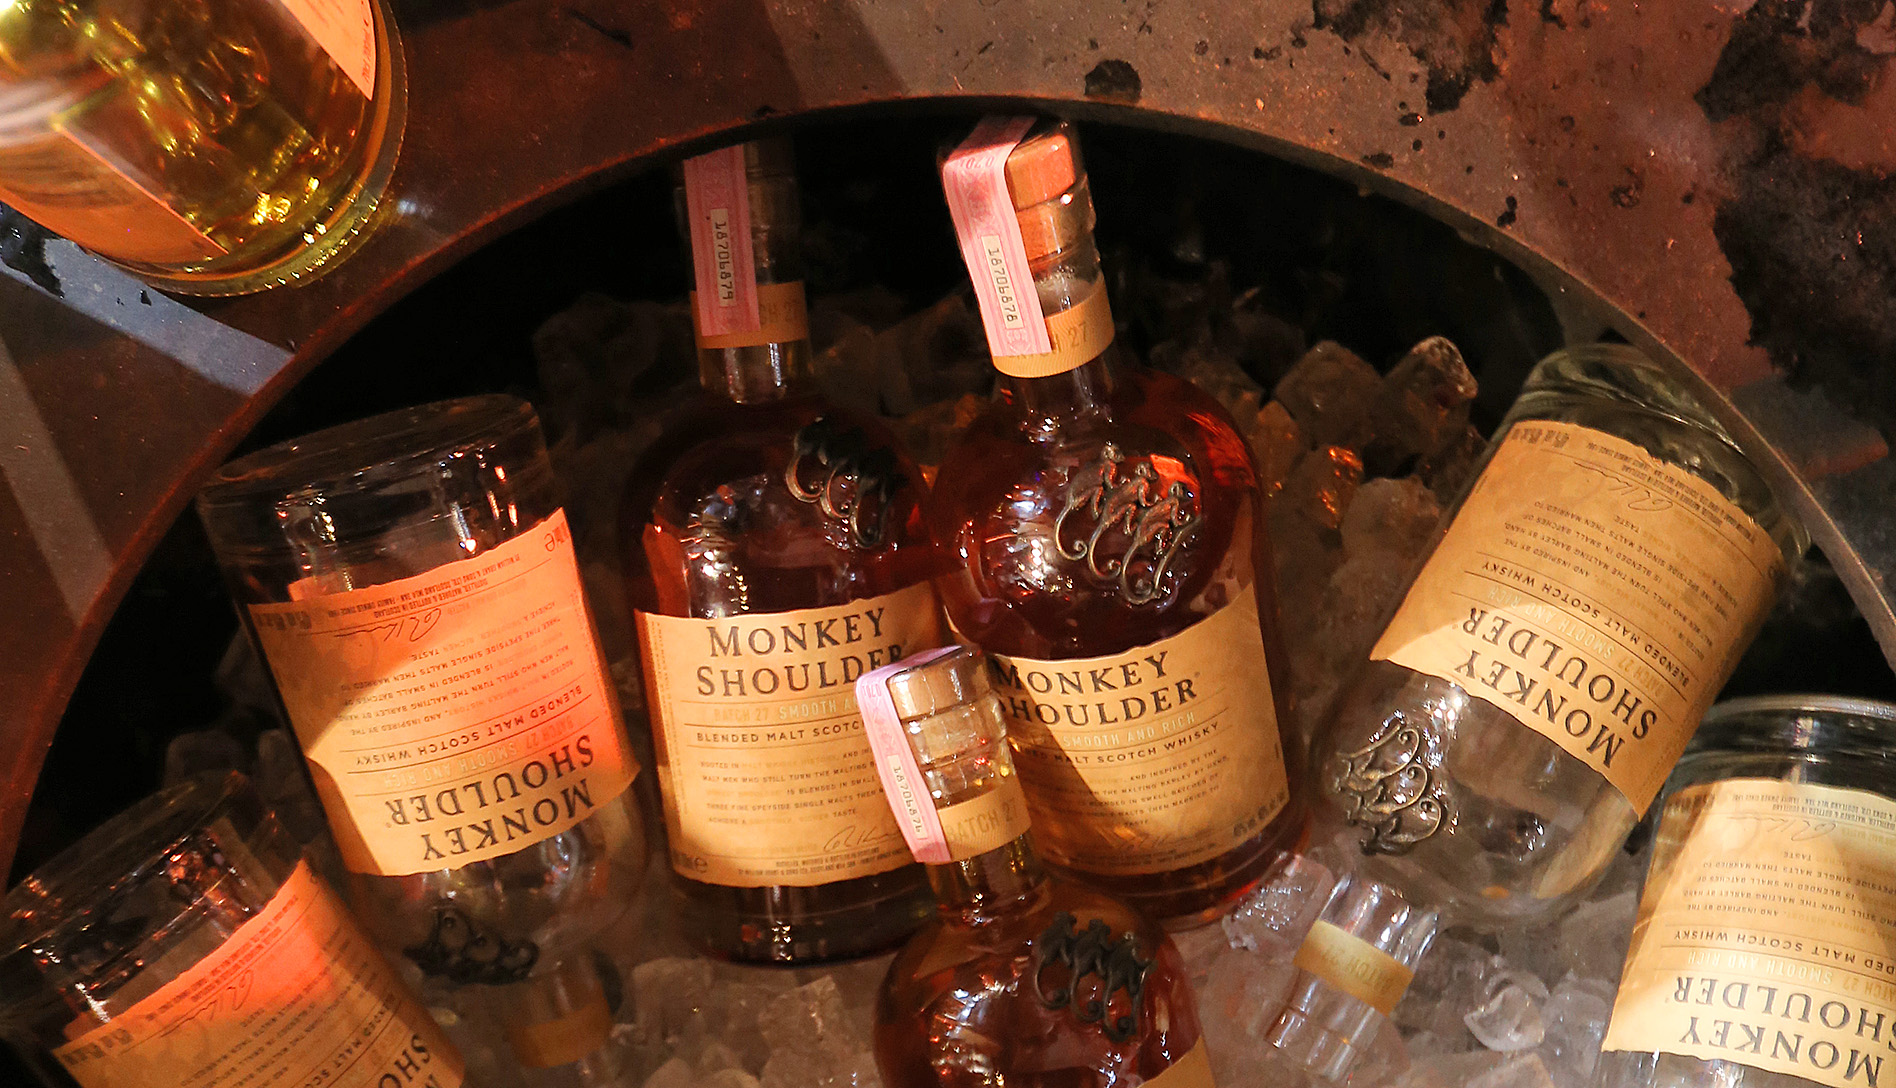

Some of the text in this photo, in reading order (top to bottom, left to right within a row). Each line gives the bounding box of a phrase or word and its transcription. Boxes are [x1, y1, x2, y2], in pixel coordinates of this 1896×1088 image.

[714, 221, 733, 300] 18706879
[986, 246, 1019, 324] 18706878
[1068, 324, 1089, 349] 27
[1536, 516, 1572, 534] BATCHES
[1584, 519, 1606, 533] THEN
[1541, 535, 1572, 552] BARLEY
[1576, 531, 1602, 548] SMALL
[1609, 530, 1635, 548] MALTS
[1504, 538, 1589, 577] AND INSPIRED BY THE
[1573, 548, 1610, 570] MALTING
[1616, 552, 1652, 577] BLENDED
[1637, 545, 1666, 567] SINGLE
[1482, 561, 1535, 587] WHISKY
[1611, 567, 1627, 581] THE
[1667, 564, 1700, 593] SPEYSIDE
[1630, 578, 1650, 594] TURN
[1542, 583, 1600, 618] SCOTCH
[1653, 592, 1672, 610] STILL
[706, 607, 884, 657] MONKEY
[1604, 617, 1640, 645] MALT
[485, 634, 522, 654] SPEYSIDE
[1487, 586, 1664, 698] BATCH 27 SMOOTH AND RICH
[450, 650, 483, 666] SINGLE
[521, 662, 537, 672] WHO
[1644, 644, 1690, 688] BLENDED
[393, 672, 416, 681] THEN
[420, 663, 448, 675] MALTS
[442, 668, 481, 685] BLENDED
[496, 670, 518, 682] STILL
[994, 650, 1167, 693] MONKEY
[1462, 606, 1658, 739] SHOULDER
[396, 685, 426, 696] SMALL
[451, 689, 468, 698] THE
[471, 680, 494, 691] TURN
[410, 695, 448, 710] MALTING
[530, 685, 582, 718] BLENDED
[779, 700, 836, 720] SMOOTH
[1454, 650, 1626, 769] MONKEY
[376, 705, 408, 717] BARLEY
[424, 713, 441, 722] AND
[381, 718, 421, 732] INSPIRED
[488, 715, 524, 736] MALT
[696, 719, 863, 743] BLENDED MALT SCOTC
[1062, 712, 1194, 748] SMOOTH AND RICH
[418, 732, 480, 755] SCOTCH
[1097, 747, 1156, 763] SCOTCH
[1164, 721, 1218, 750] WHISKY
[357, 750, 412, 765] WHISKY
[458, 742, 516, 773] SMOOTH
[422, 763, 450, 781] AND
[833, 763, 867, 775] MALTING
[1150, 762, 1188, 778] INSPIRED
[382, 771, 416, 788] RICH
[385, 735, 594, 825] SHOULDER
[798, 784, 836, 794] BLENDED
[794, 800, 824, 809] SINGLE
[828, 795, 853, 804] MALTS
[420, 778, 595, 860] MONKEY
[1784, 851, 1811, 861] TASTE
[1750, 877, 1779, 886] SMALL
[1755, 864, 1851, 884] SINGLE MALTS THEN
[1797, 884, 1840, 897] BLENDED
[1716, 904, 1756, 914] INSPIRED
[1720, 890, 1876, 922] STILL TURN THE MALTING BARLEY
[1760, 908, 1778, 916] AND
[1674, 930, 1728, 942] WHISKY
[1737, 933, 1802, 952] SCOTCH
[1688, 951, 1720, 966] RICH
[1728, 952, 1758, 970] AND
[1811, 946, 1856, 964] MALT
[1765, 960, 1832, 985] SMOOTH
[333, 1037, 362, 1068] MALT
[1679, 1016, 1884, 1088] MONKEY
